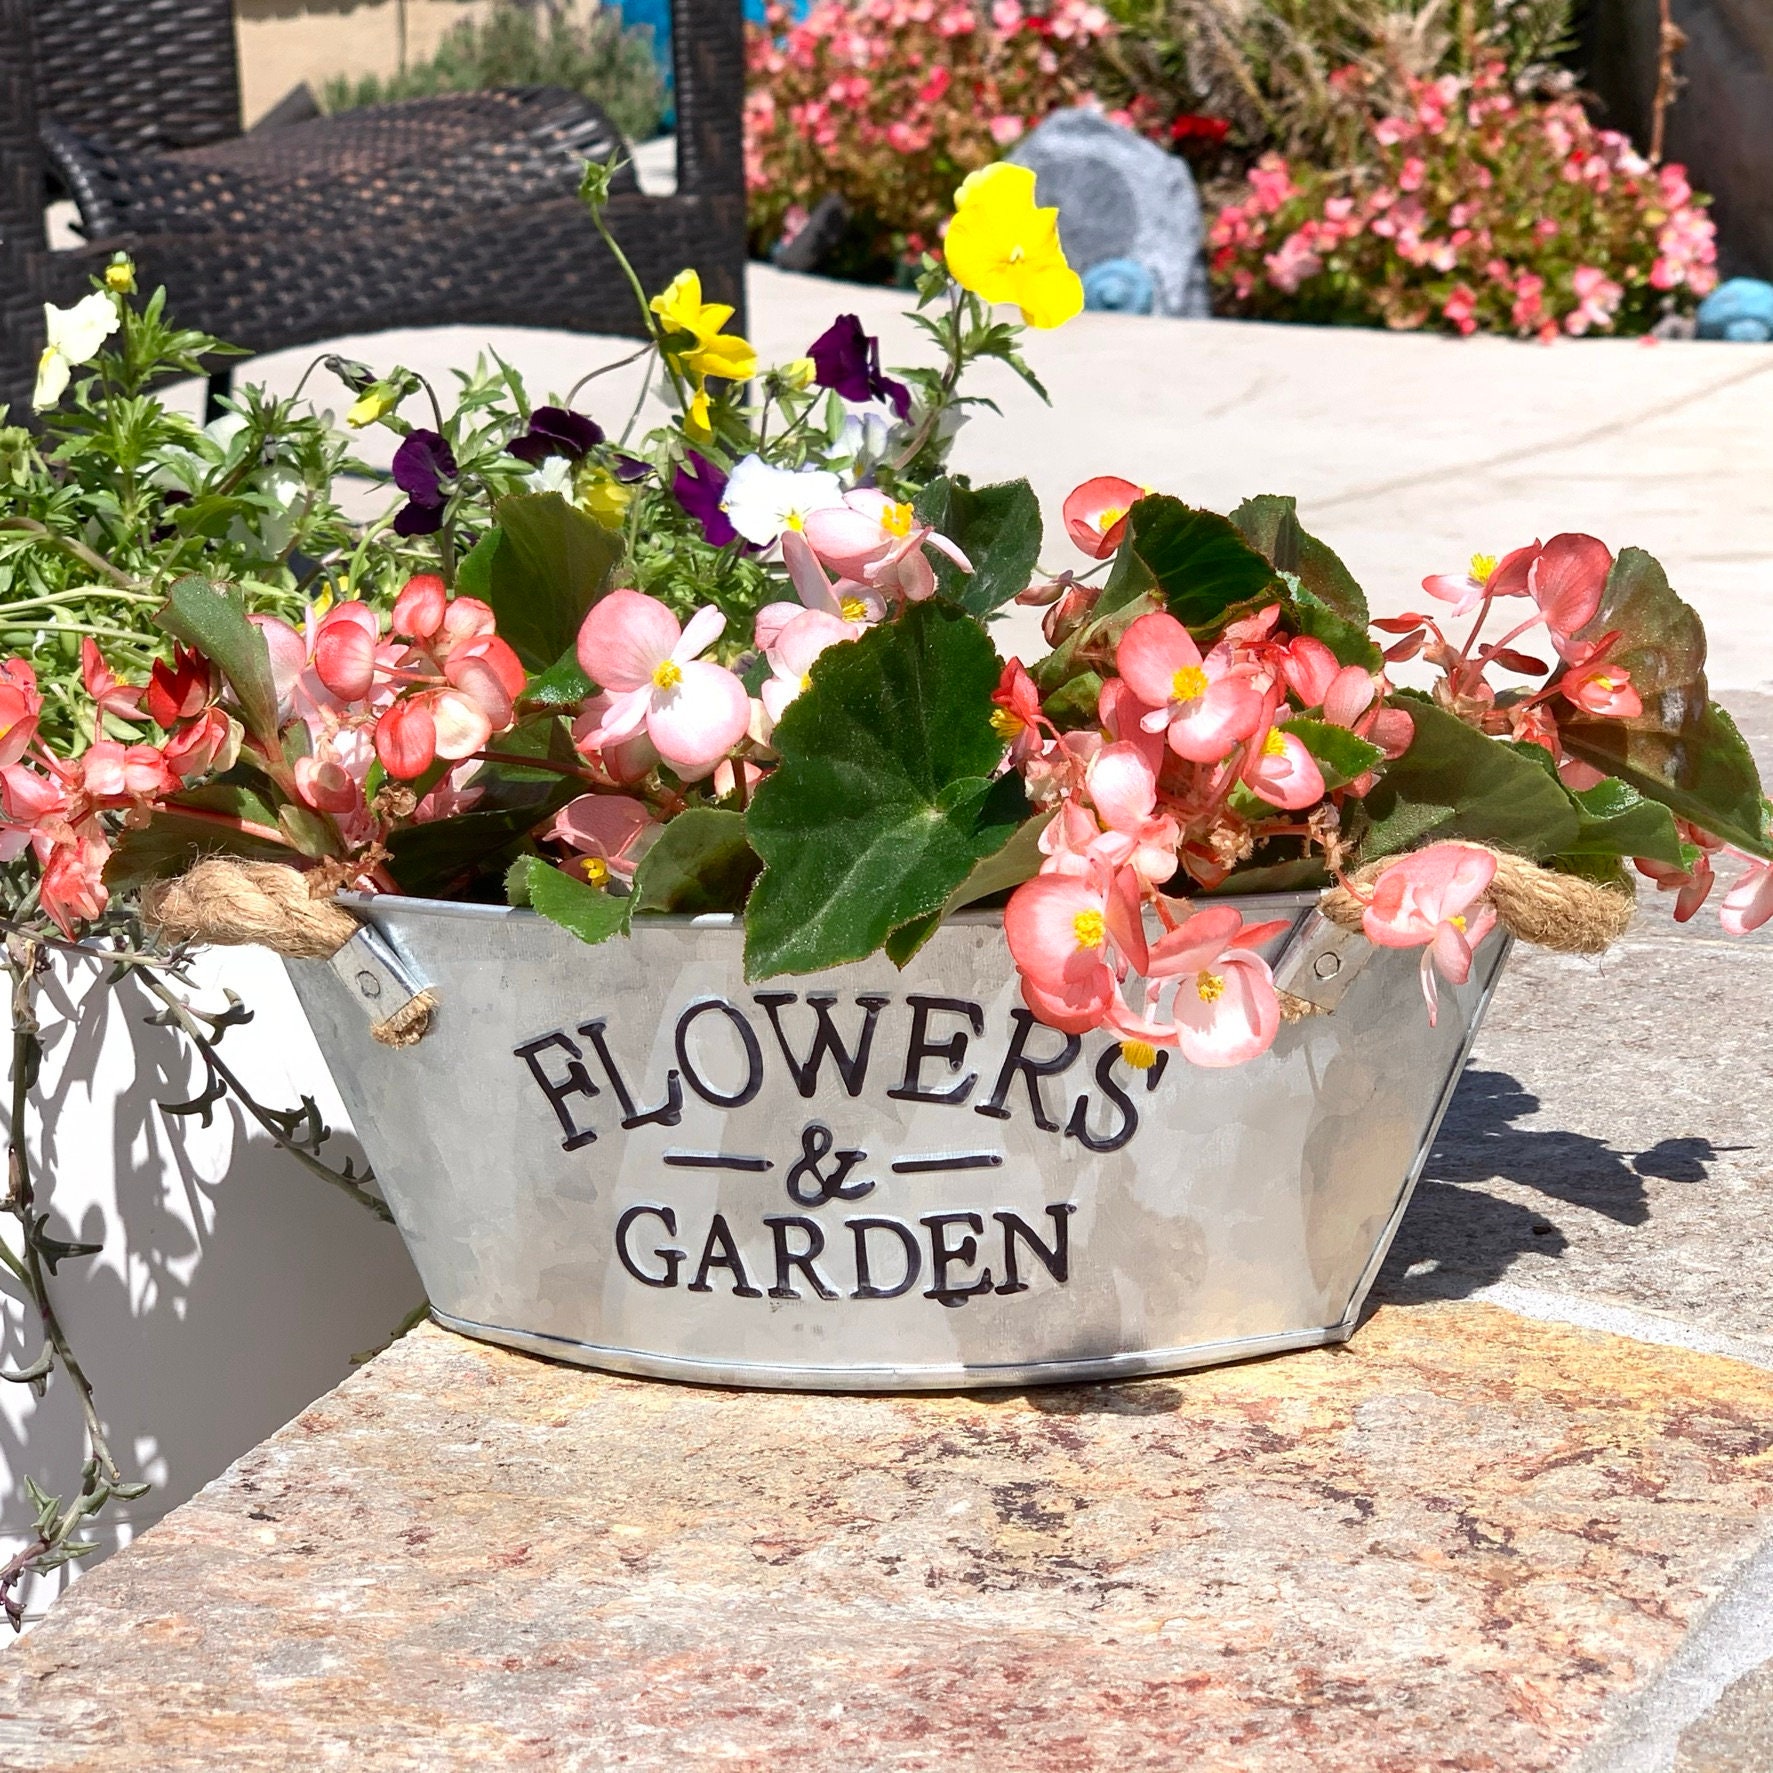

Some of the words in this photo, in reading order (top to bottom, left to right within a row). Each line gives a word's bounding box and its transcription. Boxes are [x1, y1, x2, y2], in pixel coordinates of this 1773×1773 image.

[513, 992, 1168, 1152] FLOWERS
[787, 1124, 875, 1206] &
[615, 1204, 1076, 1307] GARDEN
